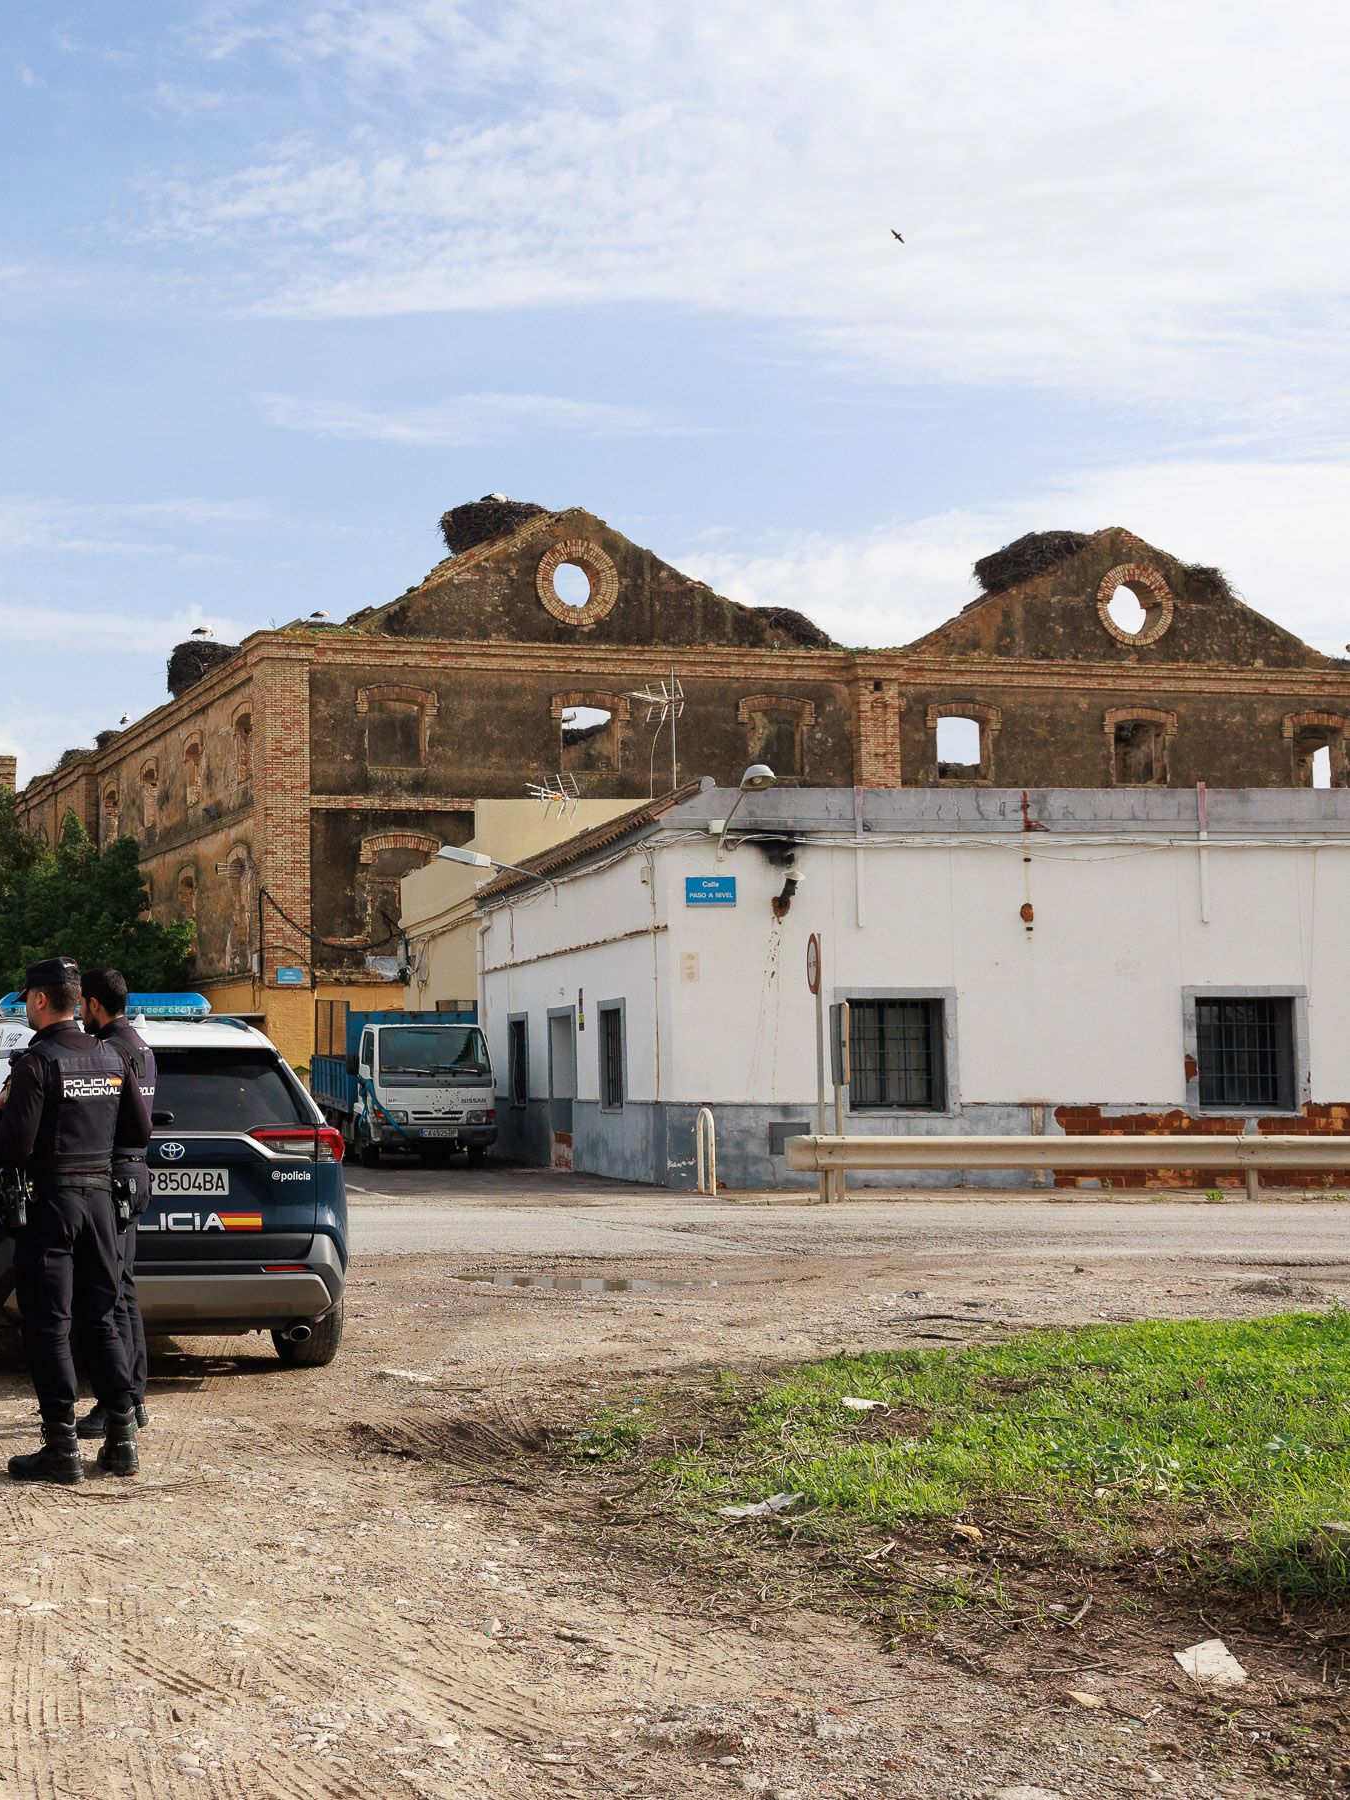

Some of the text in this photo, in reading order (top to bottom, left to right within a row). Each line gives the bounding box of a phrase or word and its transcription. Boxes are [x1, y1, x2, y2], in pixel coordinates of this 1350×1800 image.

[702, 880, 720, 888] Calle
[63, 1077, 112, 1089] POLICIA
[63, 1086, 121, 1098] NACIONAL
[150, 1172, 226, 1192] P8504BA
[271, 1170, 311, 1183] @policia
